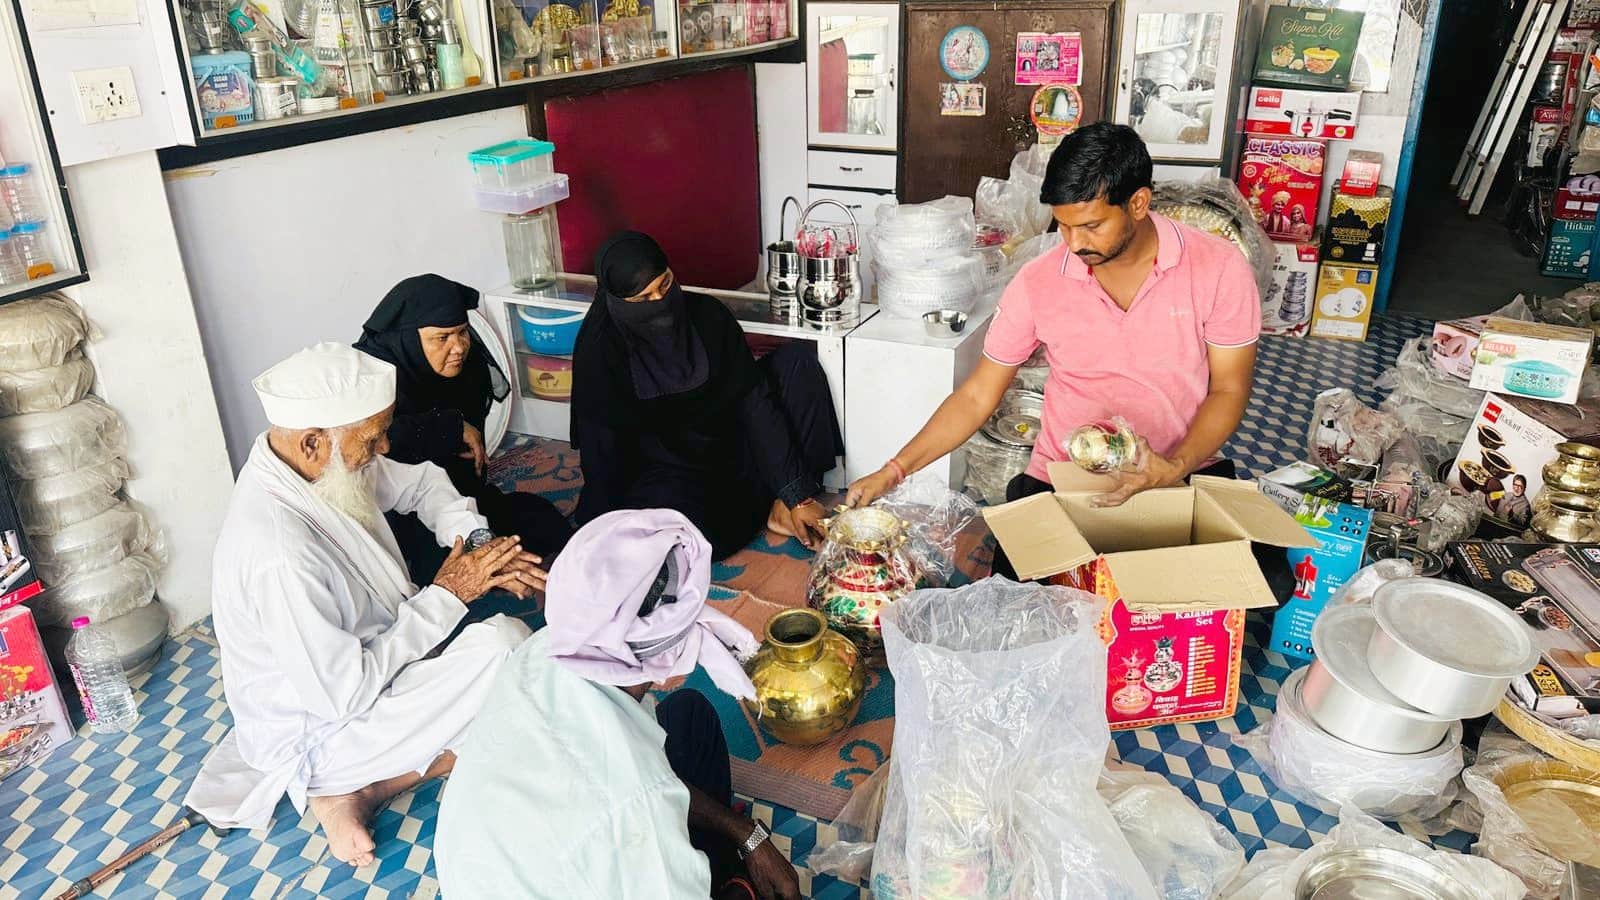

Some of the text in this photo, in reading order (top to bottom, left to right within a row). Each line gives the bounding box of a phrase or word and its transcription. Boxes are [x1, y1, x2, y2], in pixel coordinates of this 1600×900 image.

[1281, 18, 1317, 35] Super
[1248, 140, 1320, 157] CLASSIC
[1196, 617, 1213, 626] Set
